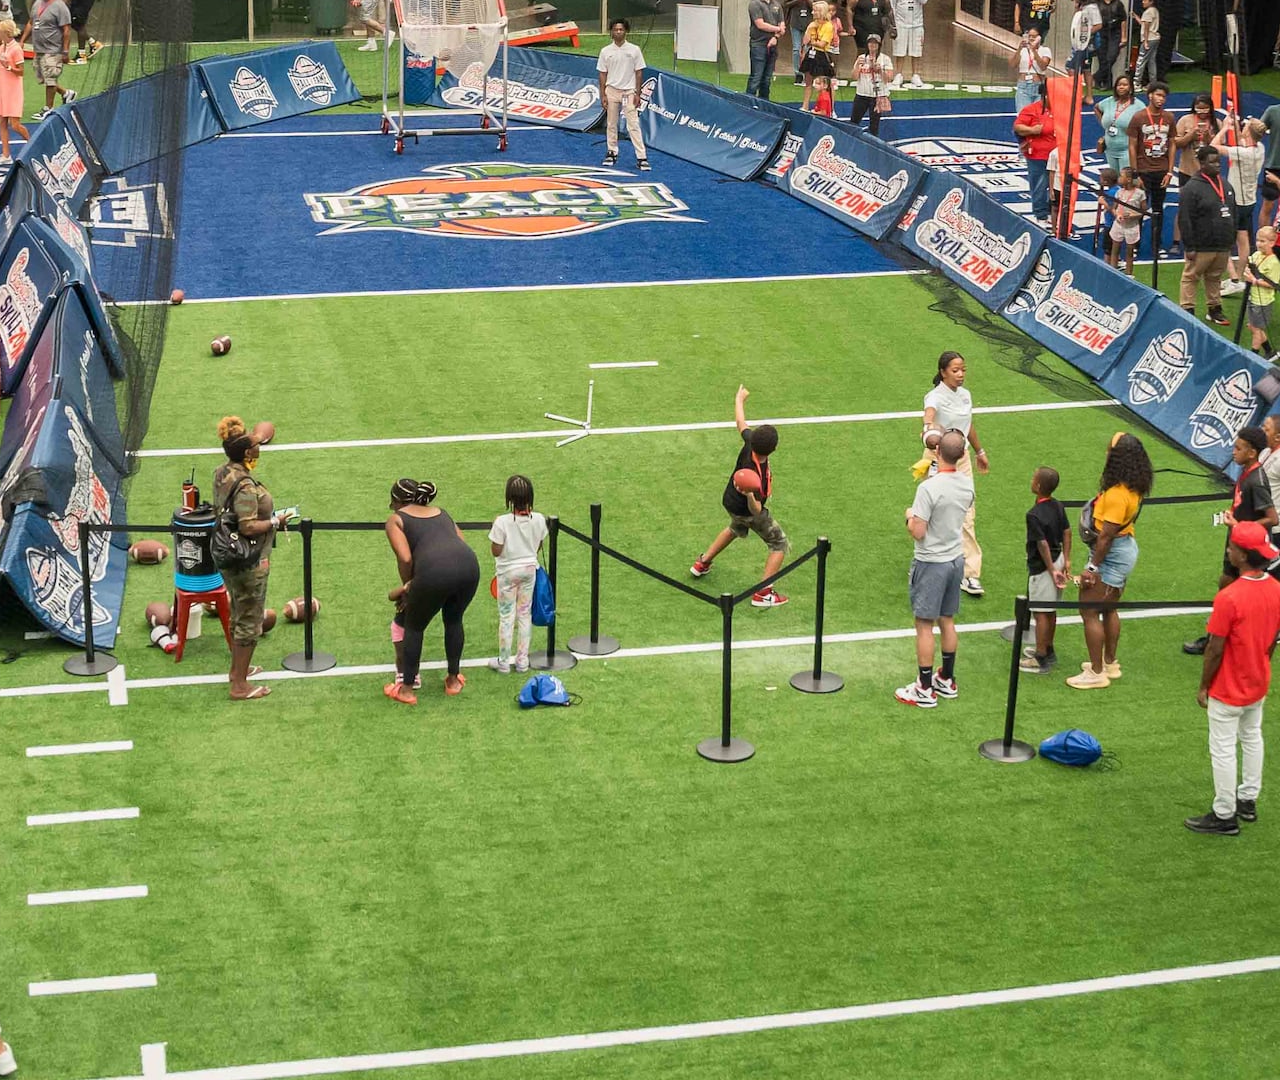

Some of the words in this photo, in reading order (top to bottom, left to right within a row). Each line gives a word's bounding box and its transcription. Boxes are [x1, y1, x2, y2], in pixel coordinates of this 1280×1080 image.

[509, 85, 544, 103] PEACH
[542, 93, 580, 110] BOWL
[510, 103, 573, 120] ZONE
[804, 172, 842, 201] SKILL
[834, 190, 882, 218] ZONE
[843, 165, 871, 194] PEACH
[868, 176, 890, 201] BOWL
[321, 186, 667, 218] PEACH
[400, 207, 609, 221] BOWL
[930, 229, 970, 266] SKILL
[959, 255, 1004, 287] ZONE
[0, 295, 22, 339] SKILL
[1046, 304, 1081, 335] SKILL
[1073, 324, 1114, 350] ZONE
